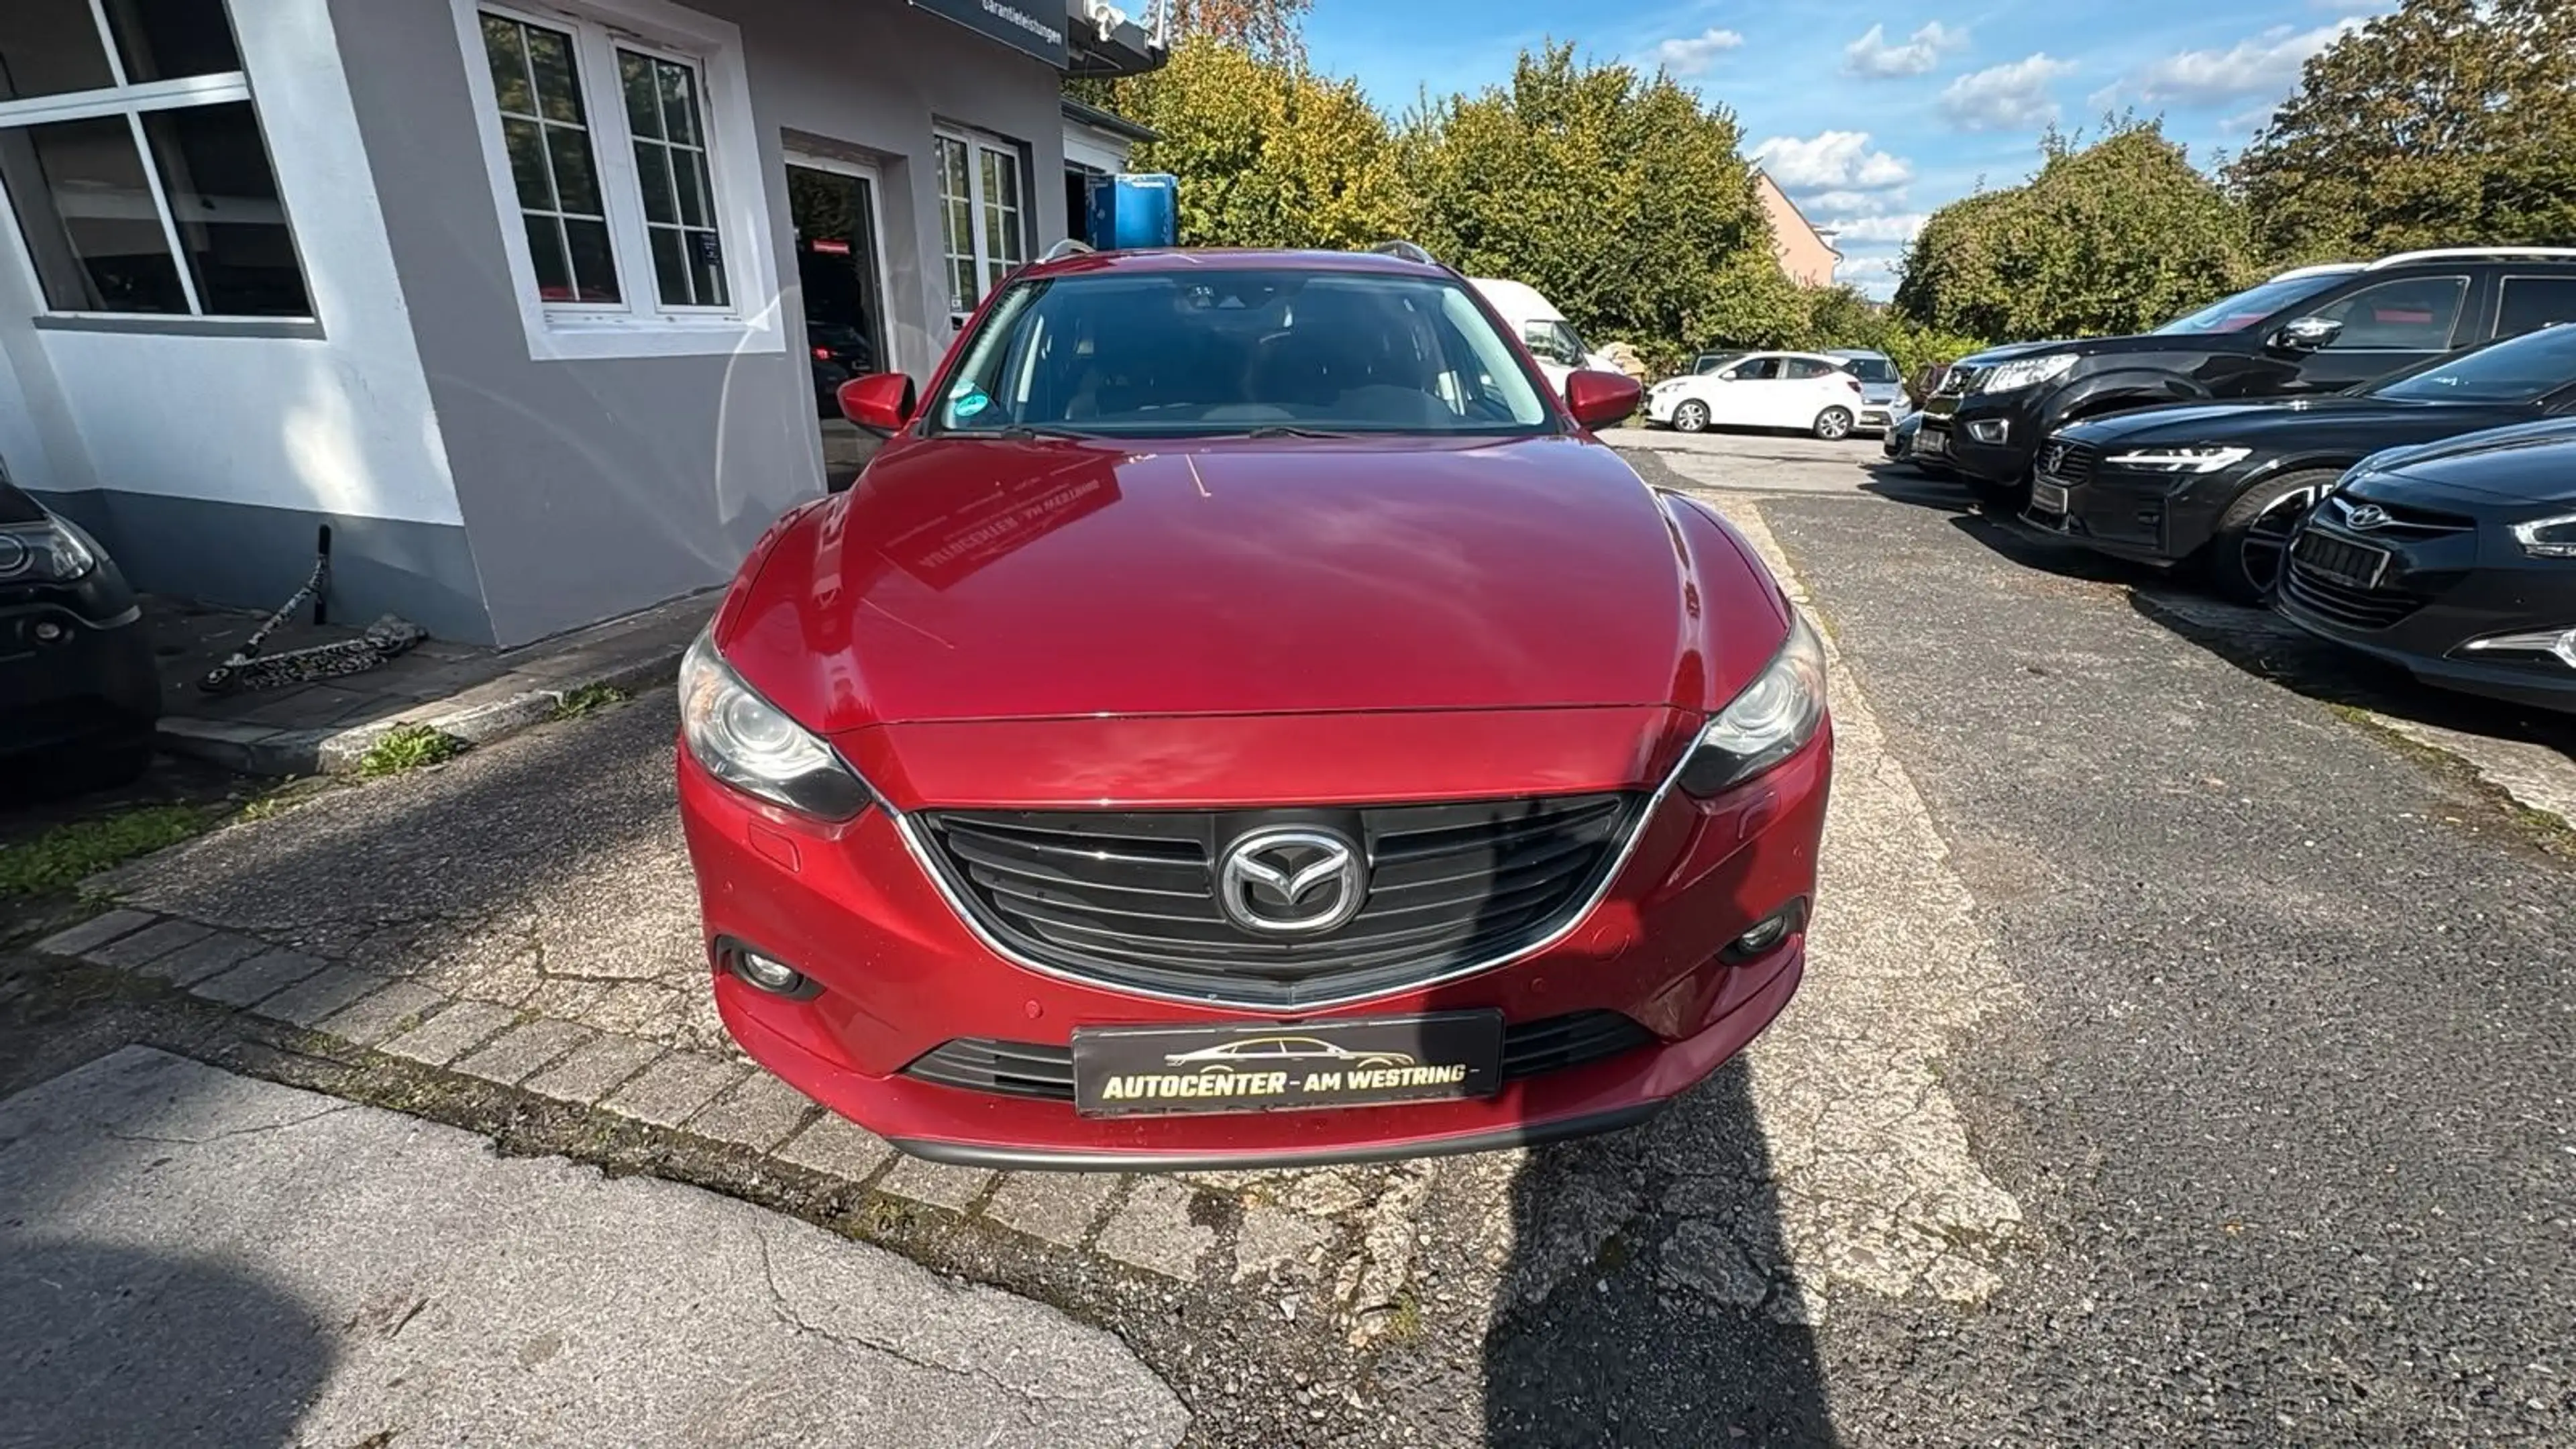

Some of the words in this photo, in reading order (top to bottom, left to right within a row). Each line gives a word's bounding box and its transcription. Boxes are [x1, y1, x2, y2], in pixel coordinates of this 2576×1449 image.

[1102, 1072, 1287, 1099] AUTOCENTER
[1303, 1069, 1341, 1091] AM
[1347, 1065, 1466, 1088] WESTRING
